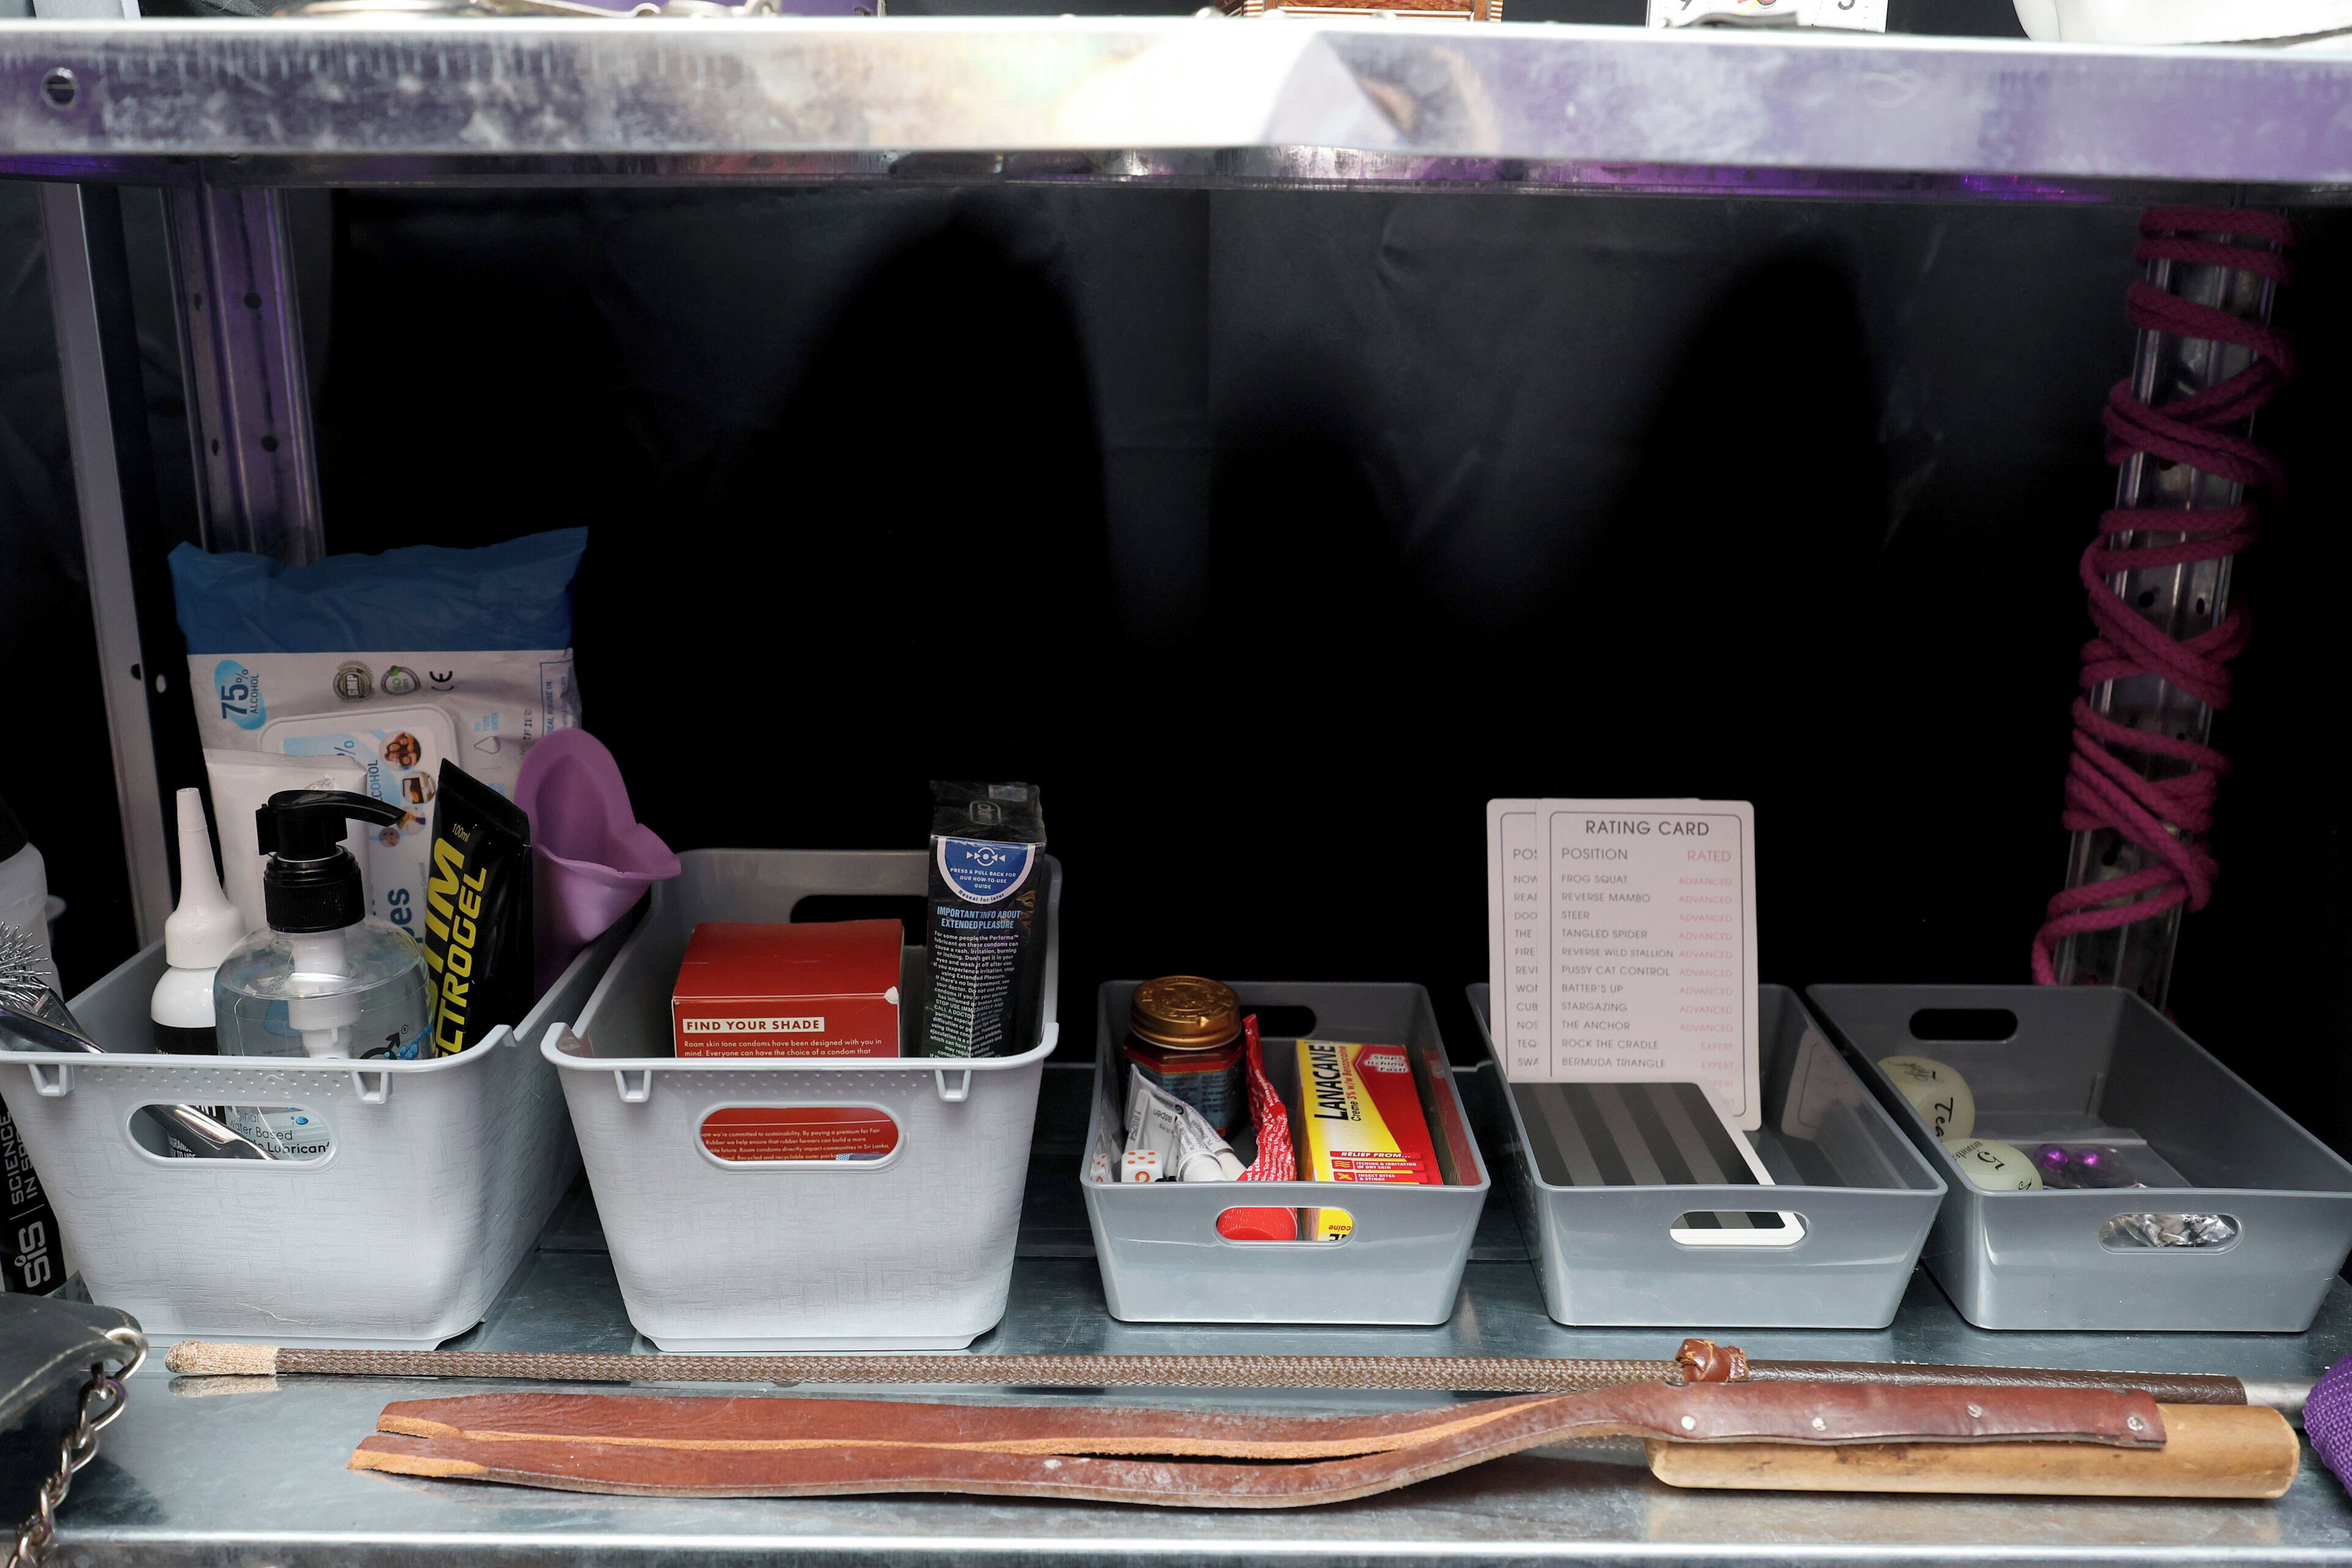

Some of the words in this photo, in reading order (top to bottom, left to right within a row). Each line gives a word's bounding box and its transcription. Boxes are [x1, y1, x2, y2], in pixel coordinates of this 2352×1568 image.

[221, 669, 249, 719] 75%
[250, 674, 259, 714] ALCOHOL
[368, 760, 382, 801] COHOL
[452, 823, 470, 843] 100ml
[1586, 821, 1651, 835] RATING
[1659, 821, 1709, 835] CARD
[1562, 848, 1627, 859] POSITION
[1688, 850, 1731, 862] RATED
[1562, 875, 1591, 883] FROG
[1594, 875, 1627, 884] SQUAT
[959, 890, 978, 901] Reseal
[1562, 893, 1604, 902] REVERSE
[1609, 894, 1651, 902] MAMBO
[937, 906, 981, 918] IMPORTANT
[941, 918, 979, 929] EXTENDED
[1562, 930, 1609, 938] TANGLED
[1613, 930, 1647, 939] SPIDER
[935, 937, 957, 946] lubricant
[1562, 948, 1600, 957] REVERSE
[1604, 949, 1627, 957] WILD
[1630, 949, 1673, 958] STALLION
[435, 867, 488, 1058] CTROGEL
[1562, 966, 1592, 974] PUSSY
[1596, 967, 1616, 975] CAT
[1620, 967, 1670, 976] CONTROL
[1610, 985, 1623, 993] UP
[1562, 1003, 1627, 1012] STARGAZING
[687, 1021, 721, 1030] FIND
[726, 1021, 766, 1030] YOUR
[772, 1020, 820, 1029] SHADE
[1562, 1020, 1579, 1029] THE
[1583, 1022, 1630, 1030] ANCHOR
[1562, 1039, 1592, 1048] ROCK
[1596, 1040, 1613, 1049] THE
[1618, 1040, 1659, 1050] CRADLE
[1562, 1058, 1612, 1066] BERMUDA
[1617, 1059, 1665, 1068] TRIANGLE
[1309, 1045, 1349, 1120] LANACANE
[1153, 1109, 1172, 1123] aspen
[1351, 1101, 1361, 1121] Creme
[230, 1120, 252, 1135] Water
[257, 1125, 293, 1141] Based
[0, 1111, 24, 1205] SCIENCE
[24, 1177, 38, 1199] IN
